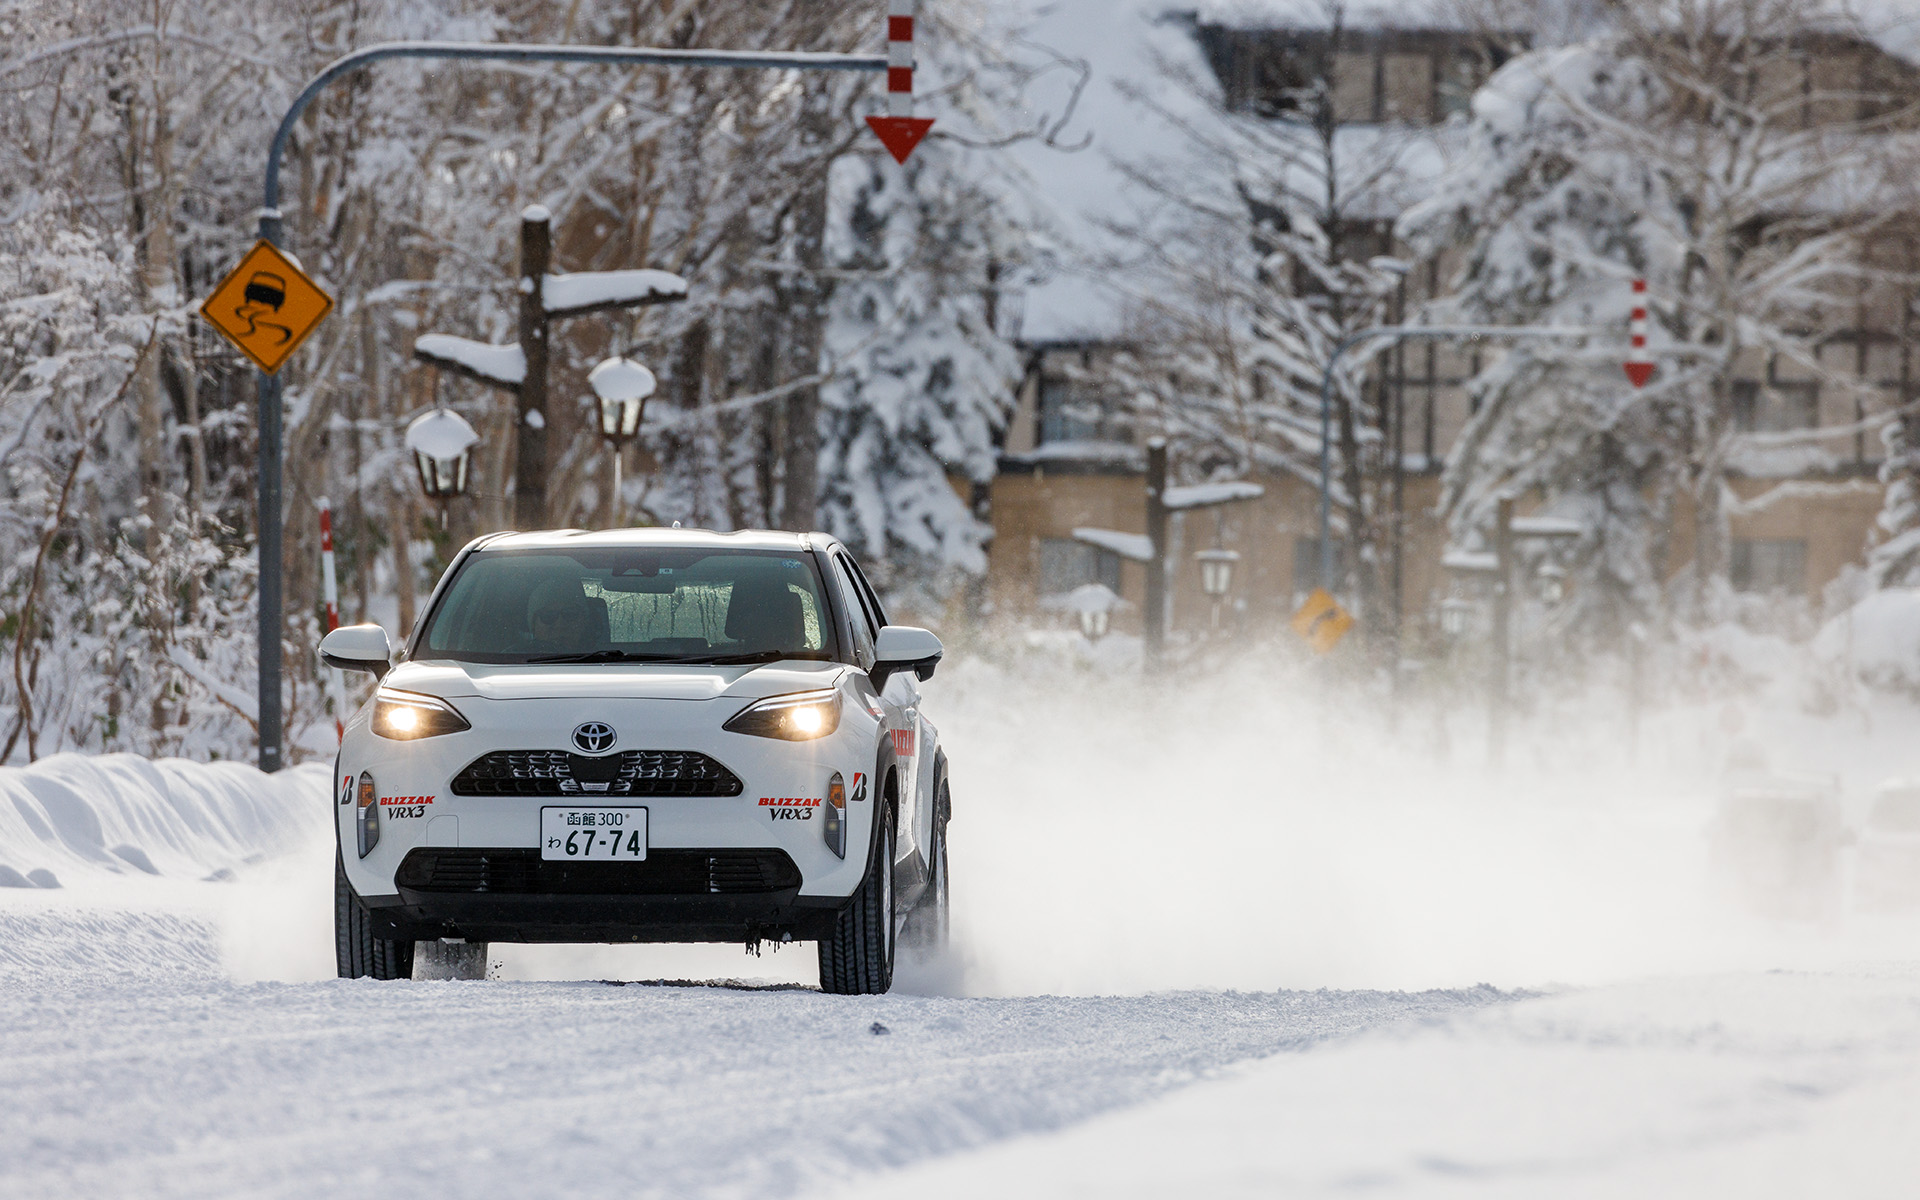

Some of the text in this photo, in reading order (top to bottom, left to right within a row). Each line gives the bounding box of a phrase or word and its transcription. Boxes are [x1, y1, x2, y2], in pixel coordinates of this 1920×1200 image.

[380, 795, 435, 805] BLIZZAK
[758, 797, 822, 807] BLIZZAK
[387, 805, 426, 820] VRX3
[769, 807, 813, 822] VRX3
[547, 830, 640, 856] わ 67-74
